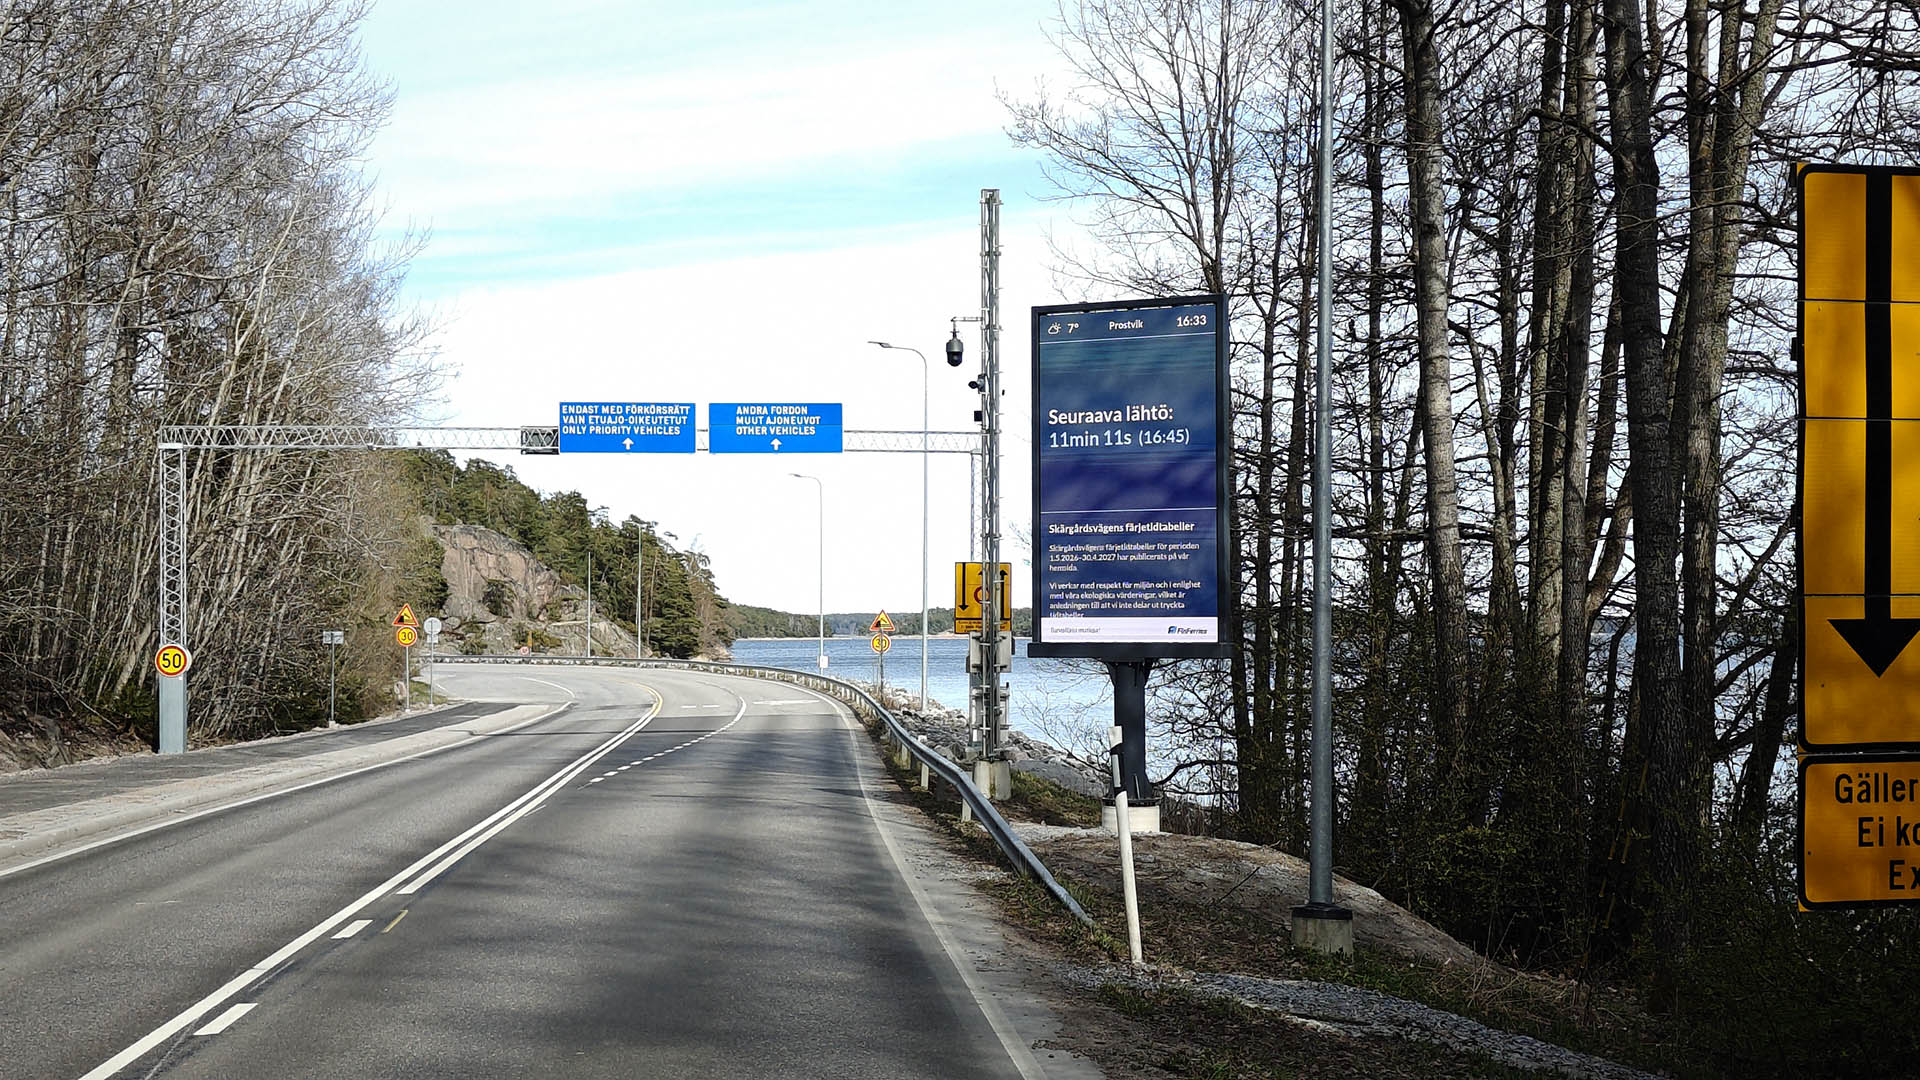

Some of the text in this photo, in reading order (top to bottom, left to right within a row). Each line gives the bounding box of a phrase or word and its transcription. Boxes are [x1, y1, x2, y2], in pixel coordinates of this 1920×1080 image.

[1109, 319, 1144, 330] Prostvik
[1176, 315, 1207, 327] 16:33
[562, 404, 691, 415] ENDAST MED FÖRKÖRSRÄTT
[736, 405, 808, 415] ANDRA FORDON
[1048, 404, 1174, 425] Seuraava lähtö:
[562, 415, 688, 425] VAIN ETUAJO-OIKEUTETUT
[736, 416, 821, 425] MUUT AJONEUVOT
[562, 426, 680, 435] ONLY PRIORITY VEHICLES
[736, 426, 816, 435] OTHER VEHICLES
[1050, 428, 1190, 448] 11min 11s (16:45)
[1048, 521, 1195, 535] Skärgårdsvägens färjetidtabeller
[1168, 541, 1200, 552] perioden
[1117, 552, 1128, 561] har
[1129, 552, 1167, 562] publicerats
[1168, 552, 1177, 561] på
[1177, 552, 1190, 560] vår
[1049, 582, 1057, 590] Vi
[1057, 582, 1080, 590] verkar
[1080, 581, 1095, 589] med
[1096, 581, 1122, 591] respekt
[1155, 581, 1169, 589] och
[1172, 580, 1201, 590] enlighet
[1049, 592, 1064, 600] med
[1080, 591, 1116, 601] ekologiska
[1158, 590, 1177, 599] vilket
[1049, 601, 1090, 610] anledningen
[1091, 601, 1100, 609] till
[1100, 601, 1111, 609] att
[1118, 601, 1132, 609] inte
[1132, 601, 1151, 609] delar
[1151, 601, 1160, 609] ut
[1160, 601, 1185, 610] tryckta
[401, 631, 413, 641] 30
[162, 652, 181, 668] 50
[1834, 772, 1919, 804] Gäller
[1858, 816, 1884, 847] Ei
